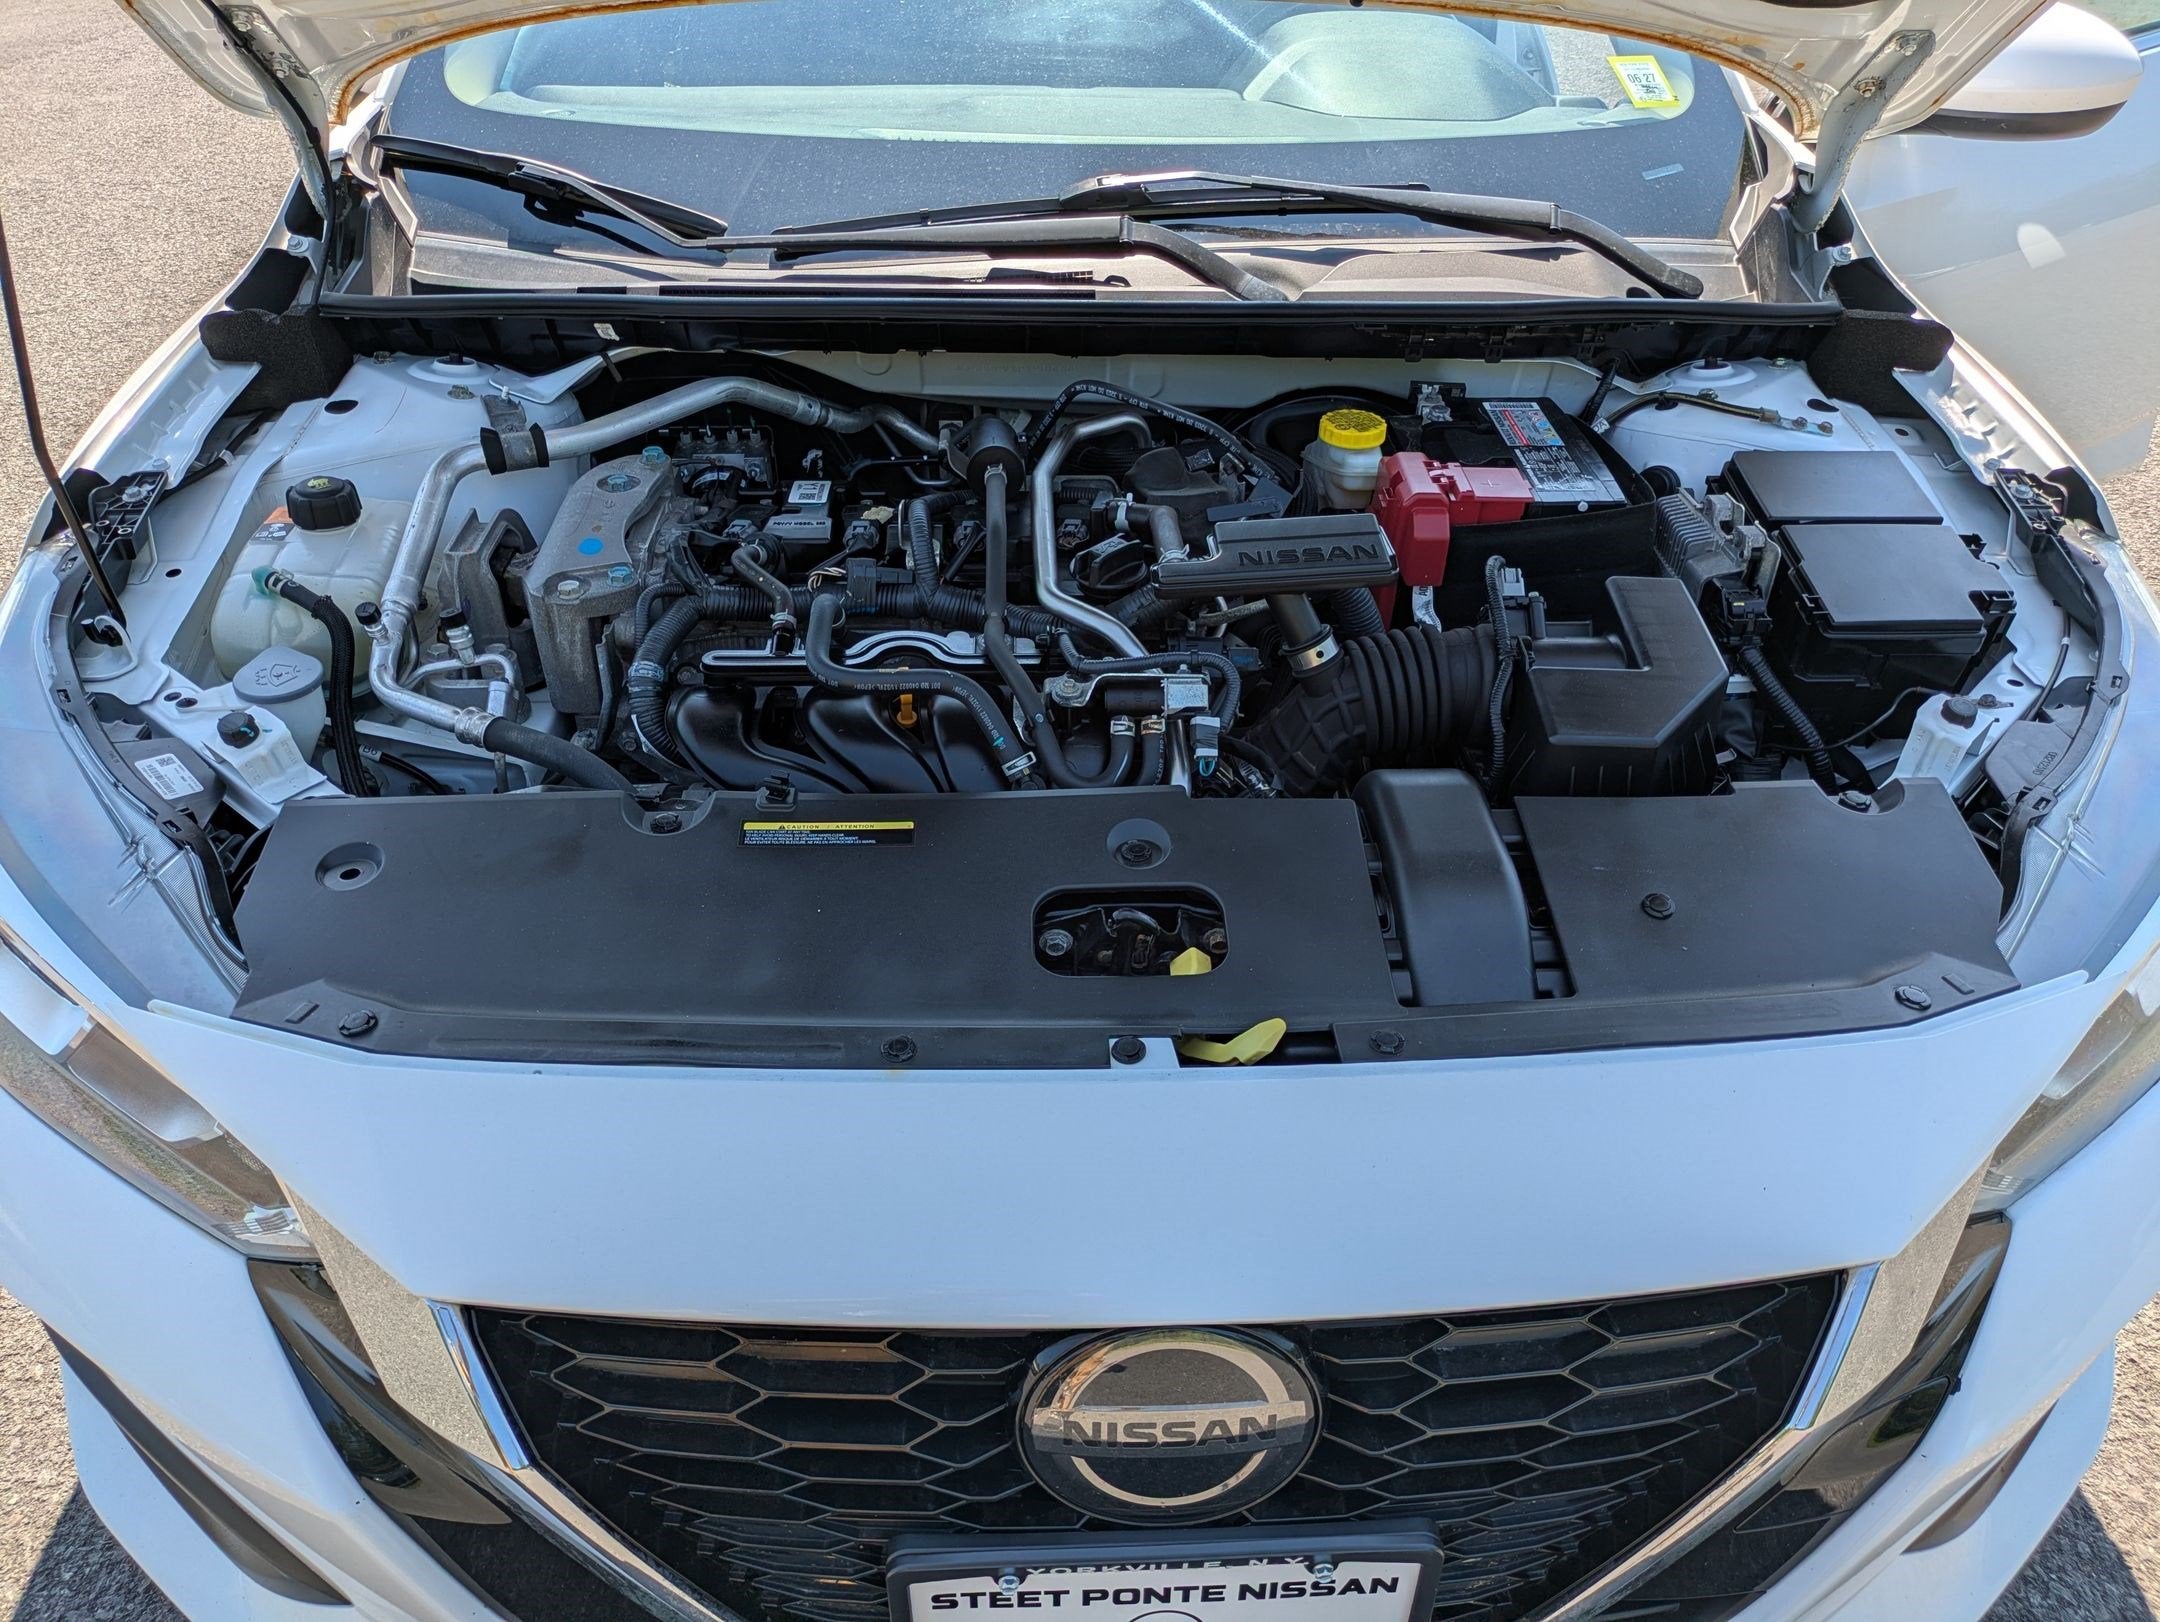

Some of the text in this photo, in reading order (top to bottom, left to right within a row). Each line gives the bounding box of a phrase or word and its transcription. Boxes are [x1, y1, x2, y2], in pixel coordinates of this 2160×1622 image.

[1627, 73, 1656, 83] 06 27
[1238, 544, 1378, 566] NISSAN
[1062, 1413, 1278, 1448] NISSAN
[931, 1576, 1399, 1609] STEET PONTE NISSAN
